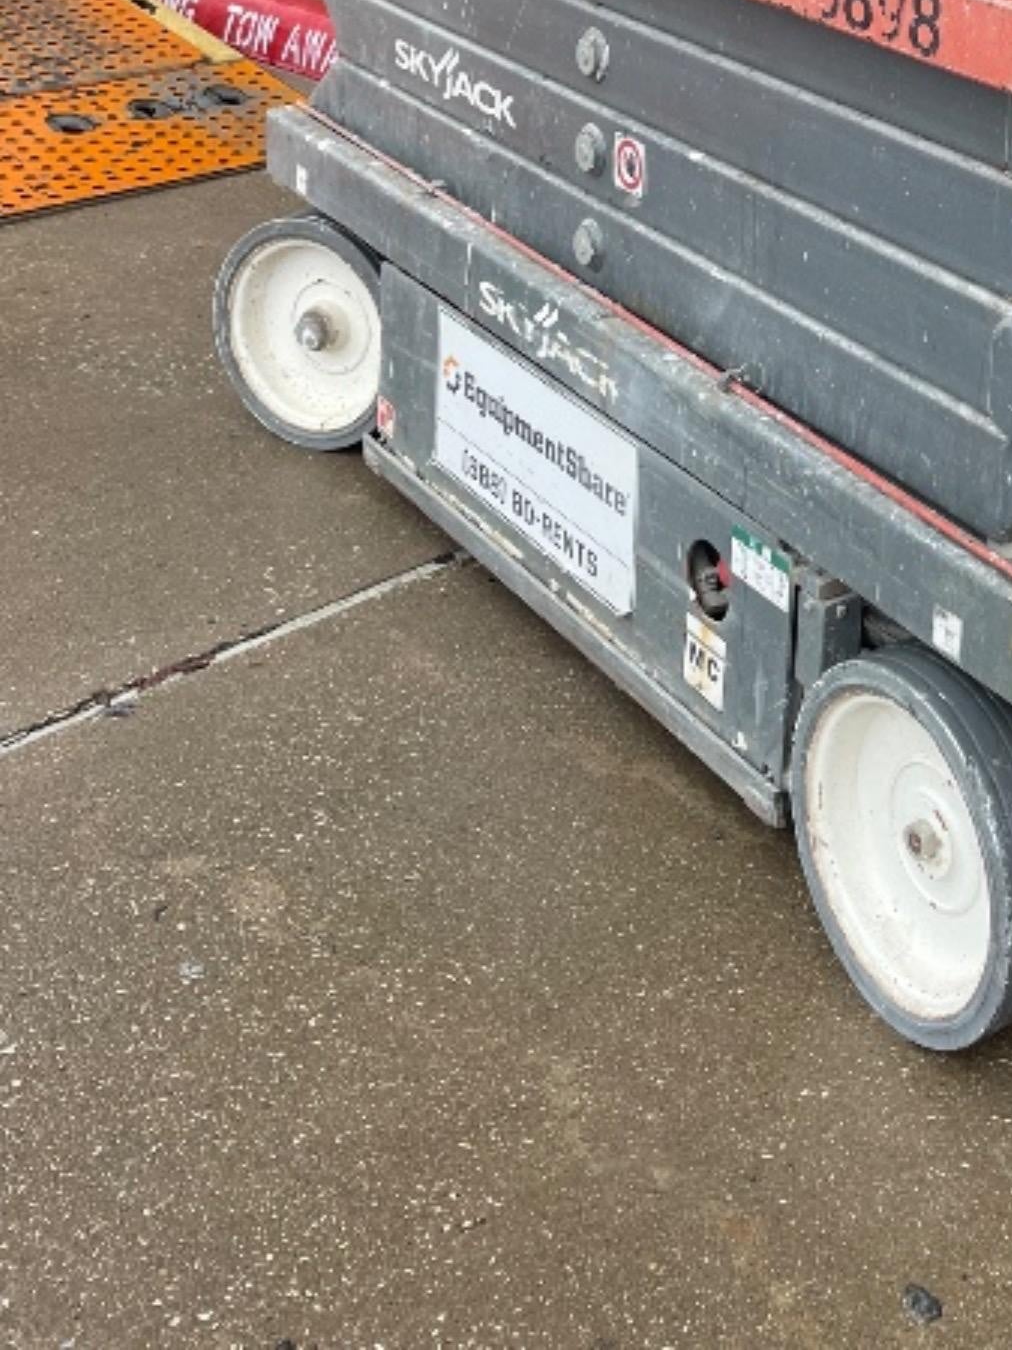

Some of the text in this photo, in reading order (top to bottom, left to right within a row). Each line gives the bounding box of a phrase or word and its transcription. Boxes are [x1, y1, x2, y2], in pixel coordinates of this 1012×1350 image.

[223, 4, 280, 55] TOW
[281, 23, 339, 72] AWA
[394, 37, 517, 130] SKYJACK
[463, 371, 628, 517] EquipmentShare
